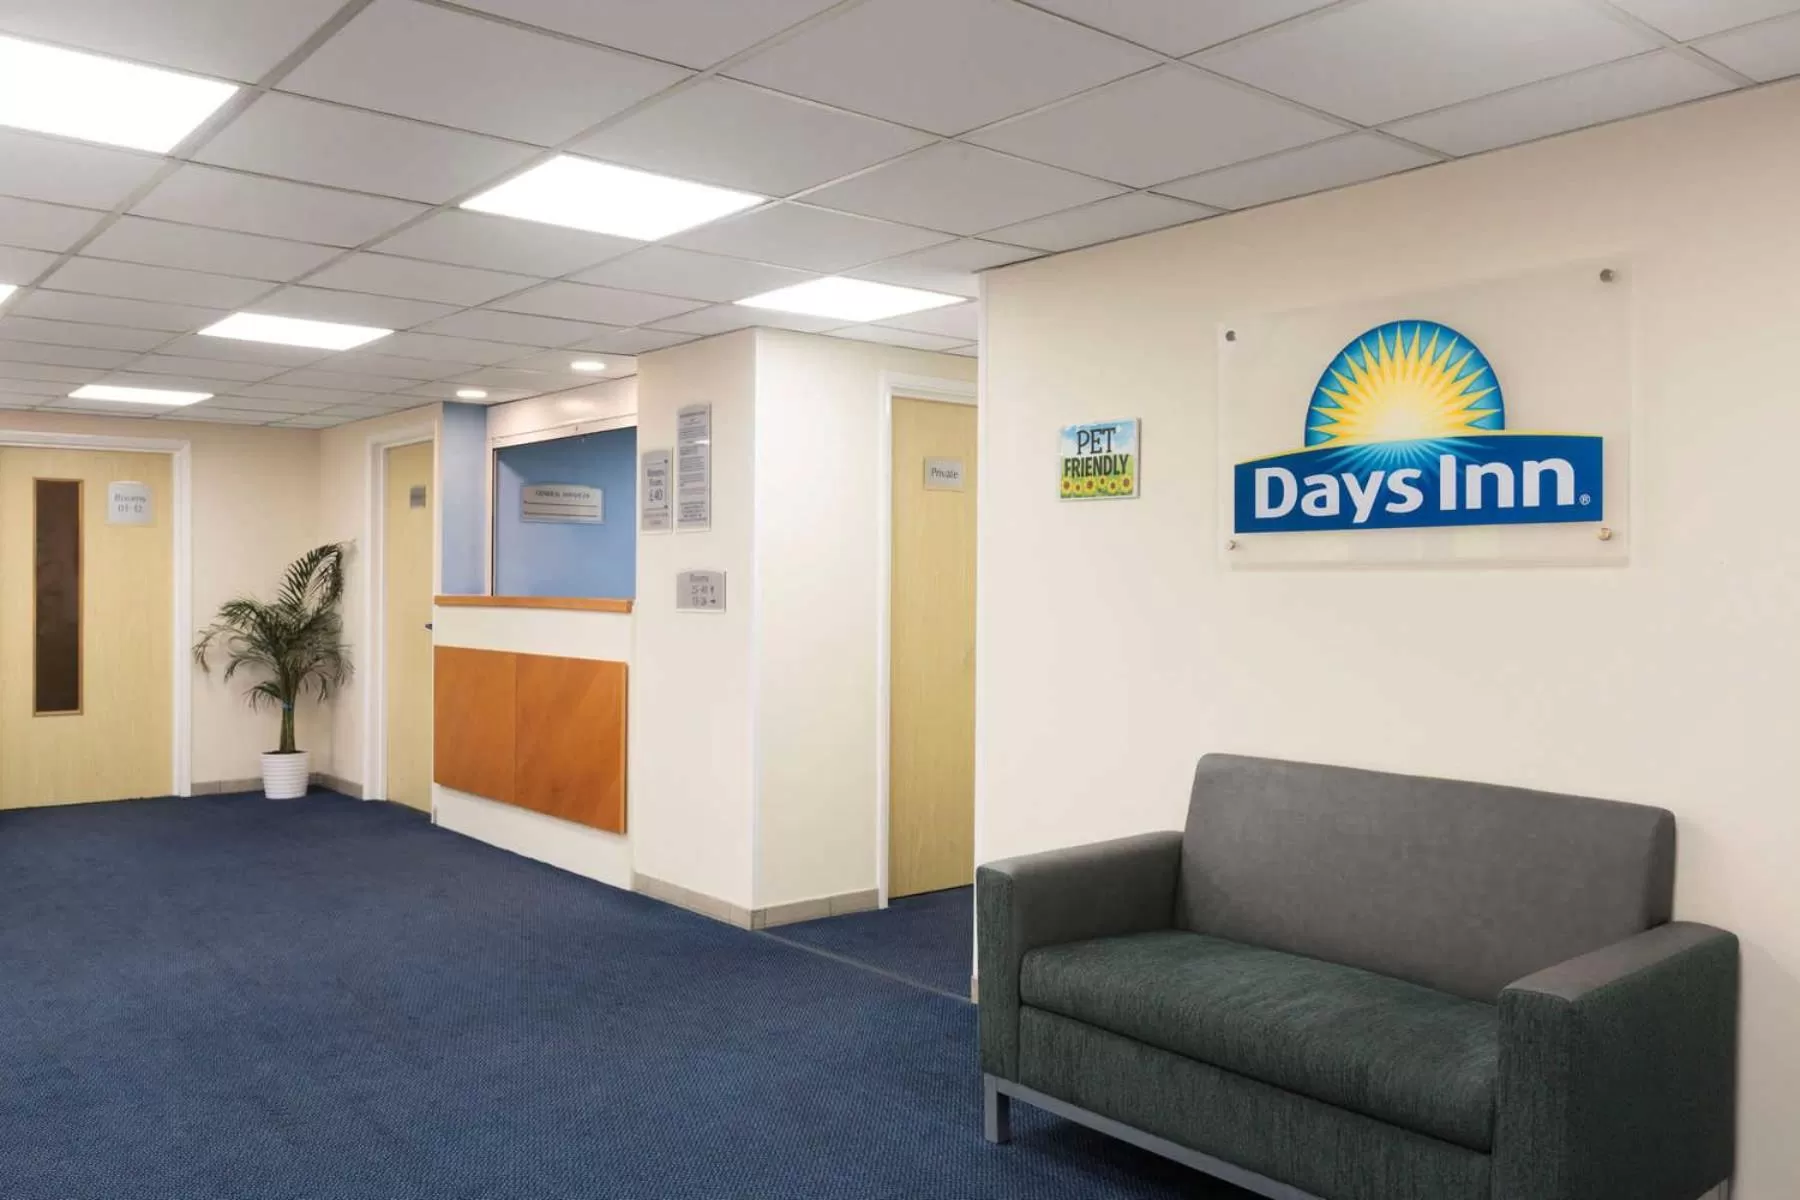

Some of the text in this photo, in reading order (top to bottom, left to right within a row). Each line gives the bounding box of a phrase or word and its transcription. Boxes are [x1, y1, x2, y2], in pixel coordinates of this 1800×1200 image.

[1076, 427, 1117, 455] PET
[931, 467, 961, 479] Private
[1064, 454, 1129, 479] FRIENDLY
[1254, 466, 1424, 524] Days
